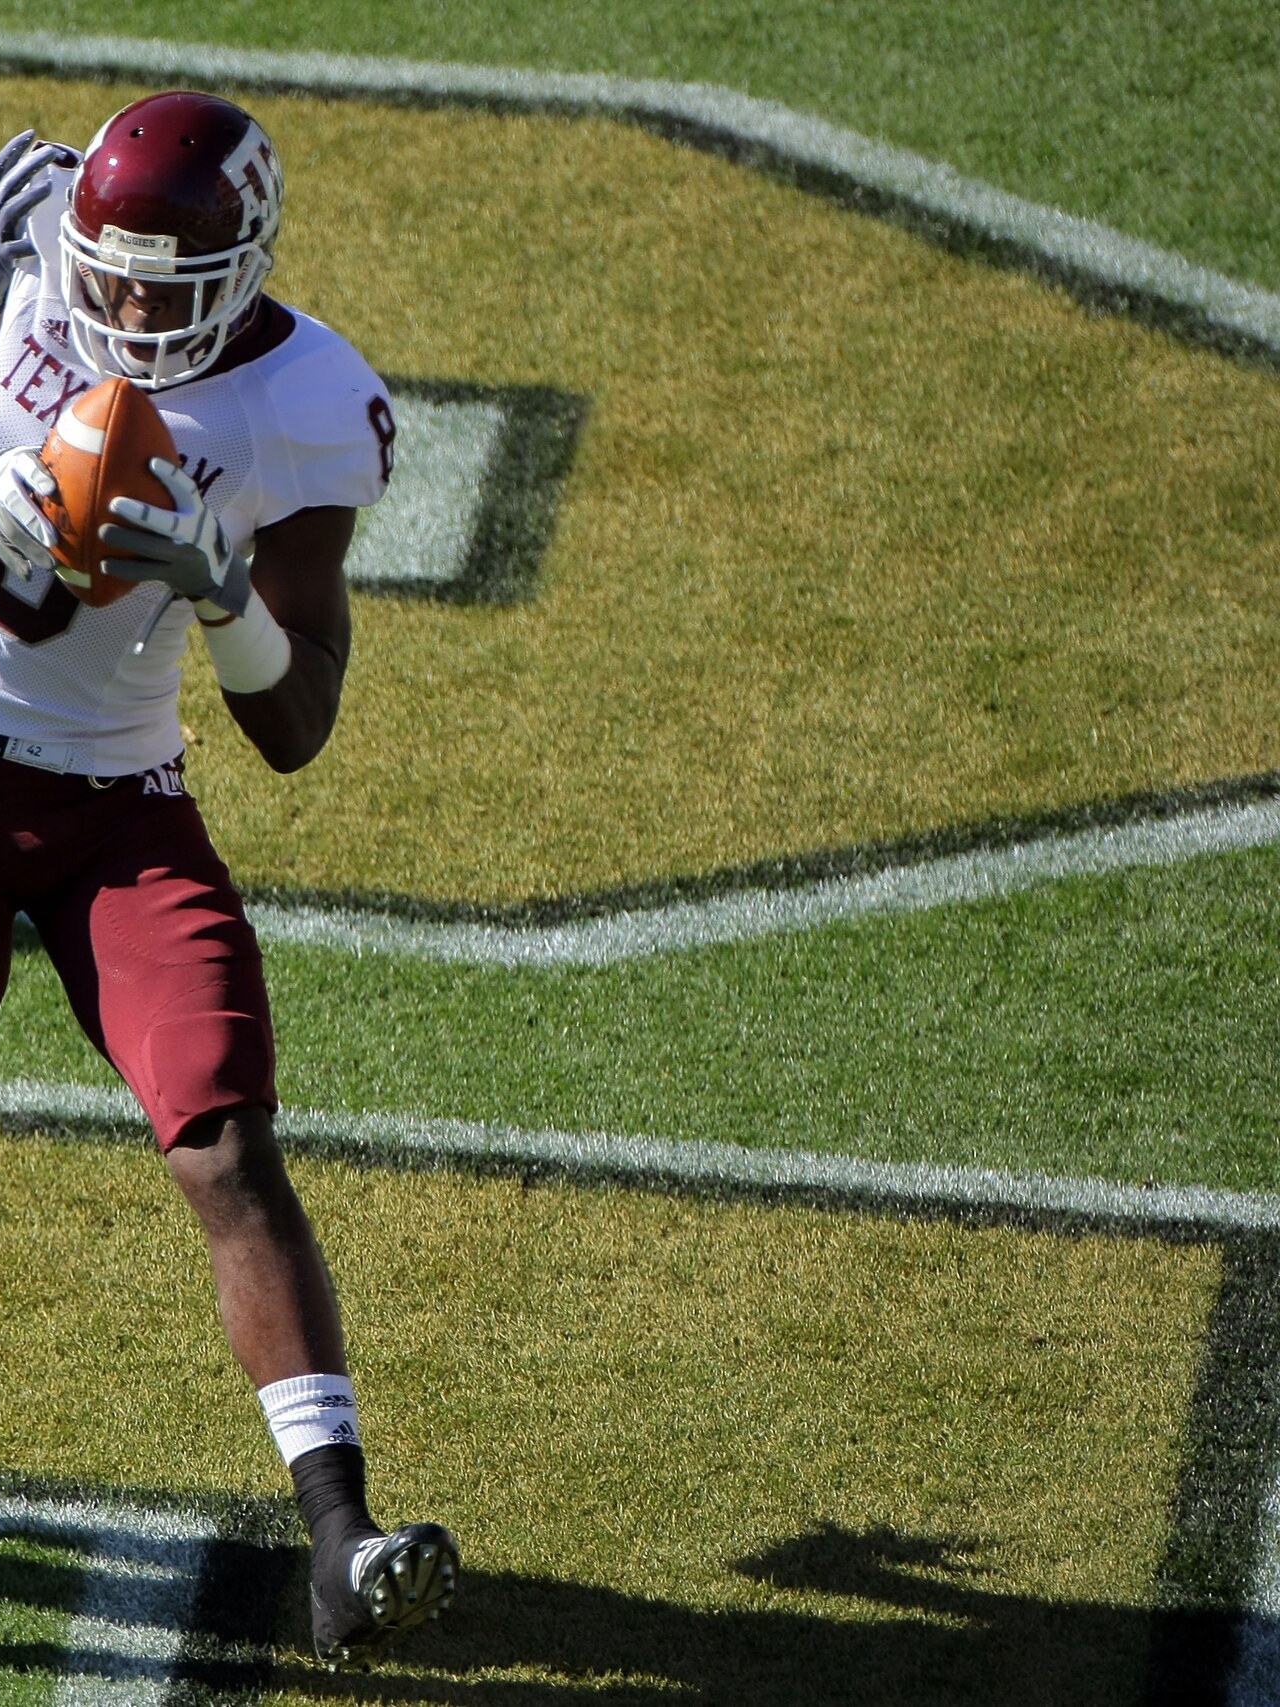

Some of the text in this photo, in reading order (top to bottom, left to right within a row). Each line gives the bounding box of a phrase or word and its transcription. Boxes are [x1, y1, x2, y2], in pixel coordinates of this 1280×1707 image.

[118, 235, 157, 248] AGGIES
[1, 333, 91, 428] TEX
[366, 393, 396, 485] 8
[26, 743, 43, 757] 42
